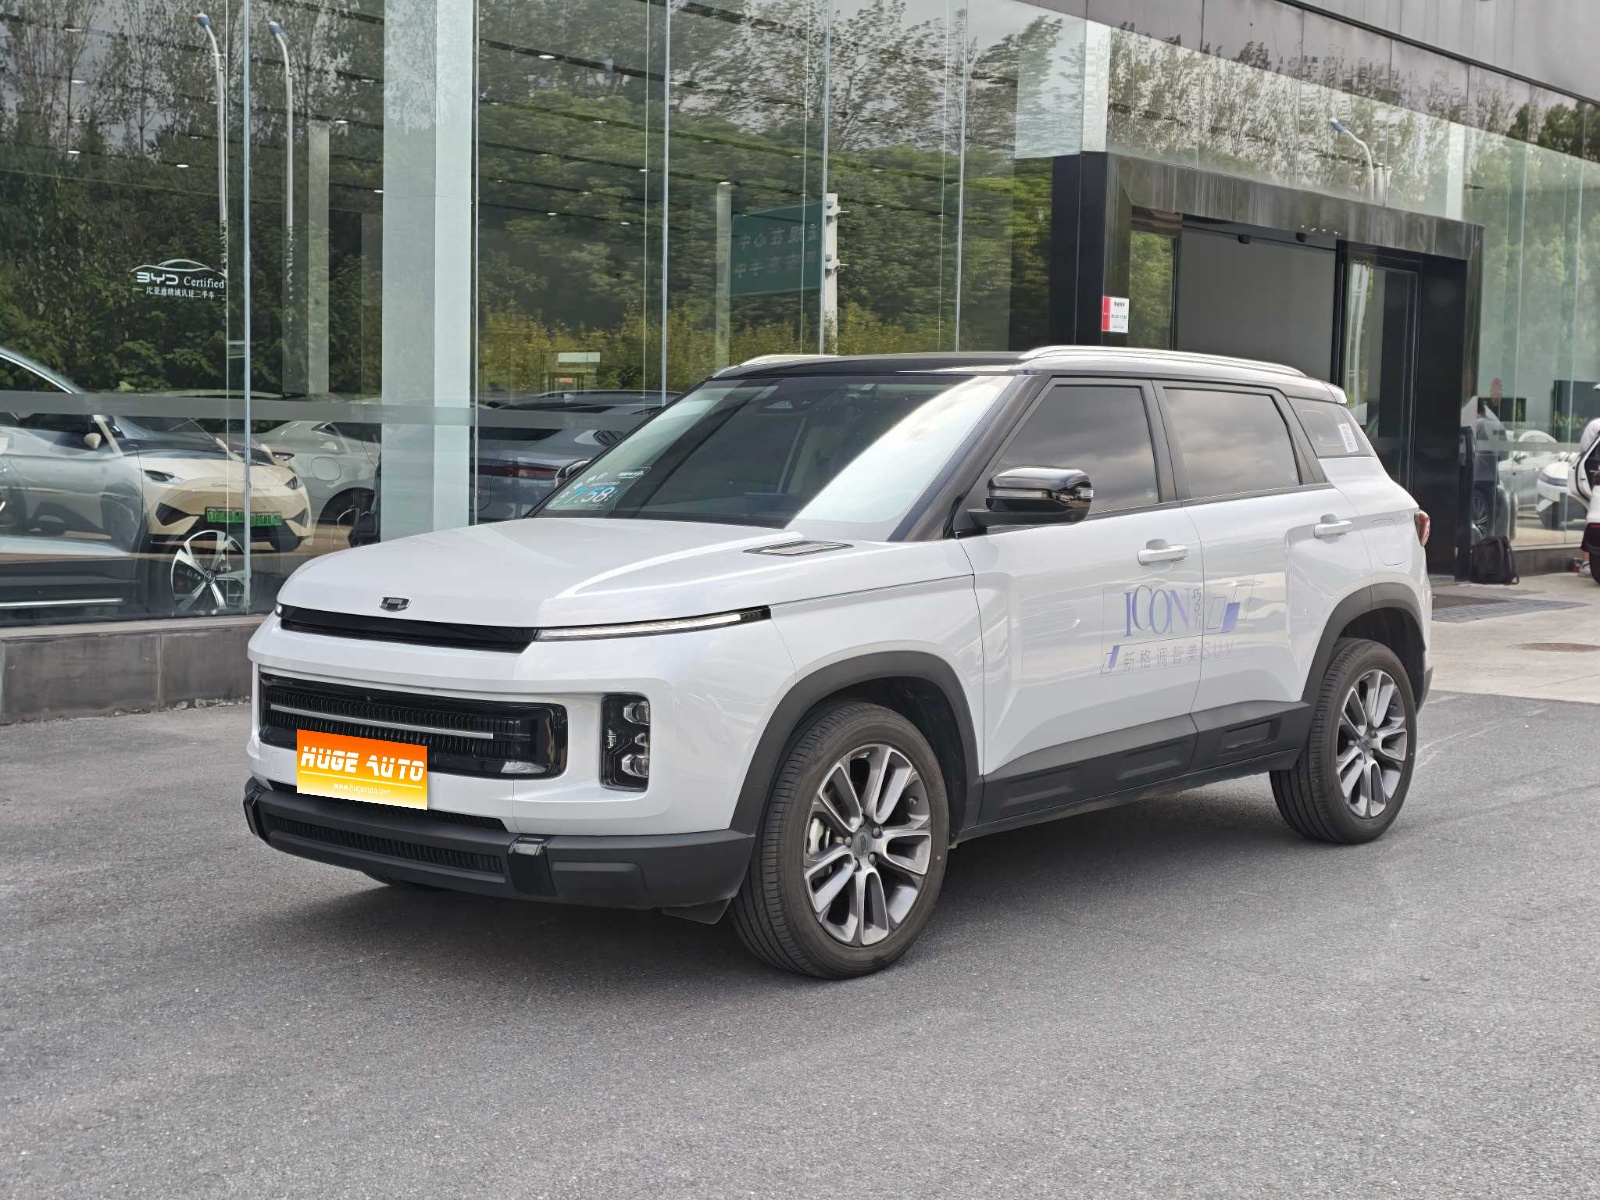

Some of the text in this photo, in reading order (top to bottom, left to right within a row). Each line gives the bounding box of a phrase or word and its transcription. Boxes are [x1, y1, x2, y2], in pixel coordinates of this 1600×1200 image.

[136, 271, 225, 289] BYD Certified
[1123, 584, 1191, 637] ICON
